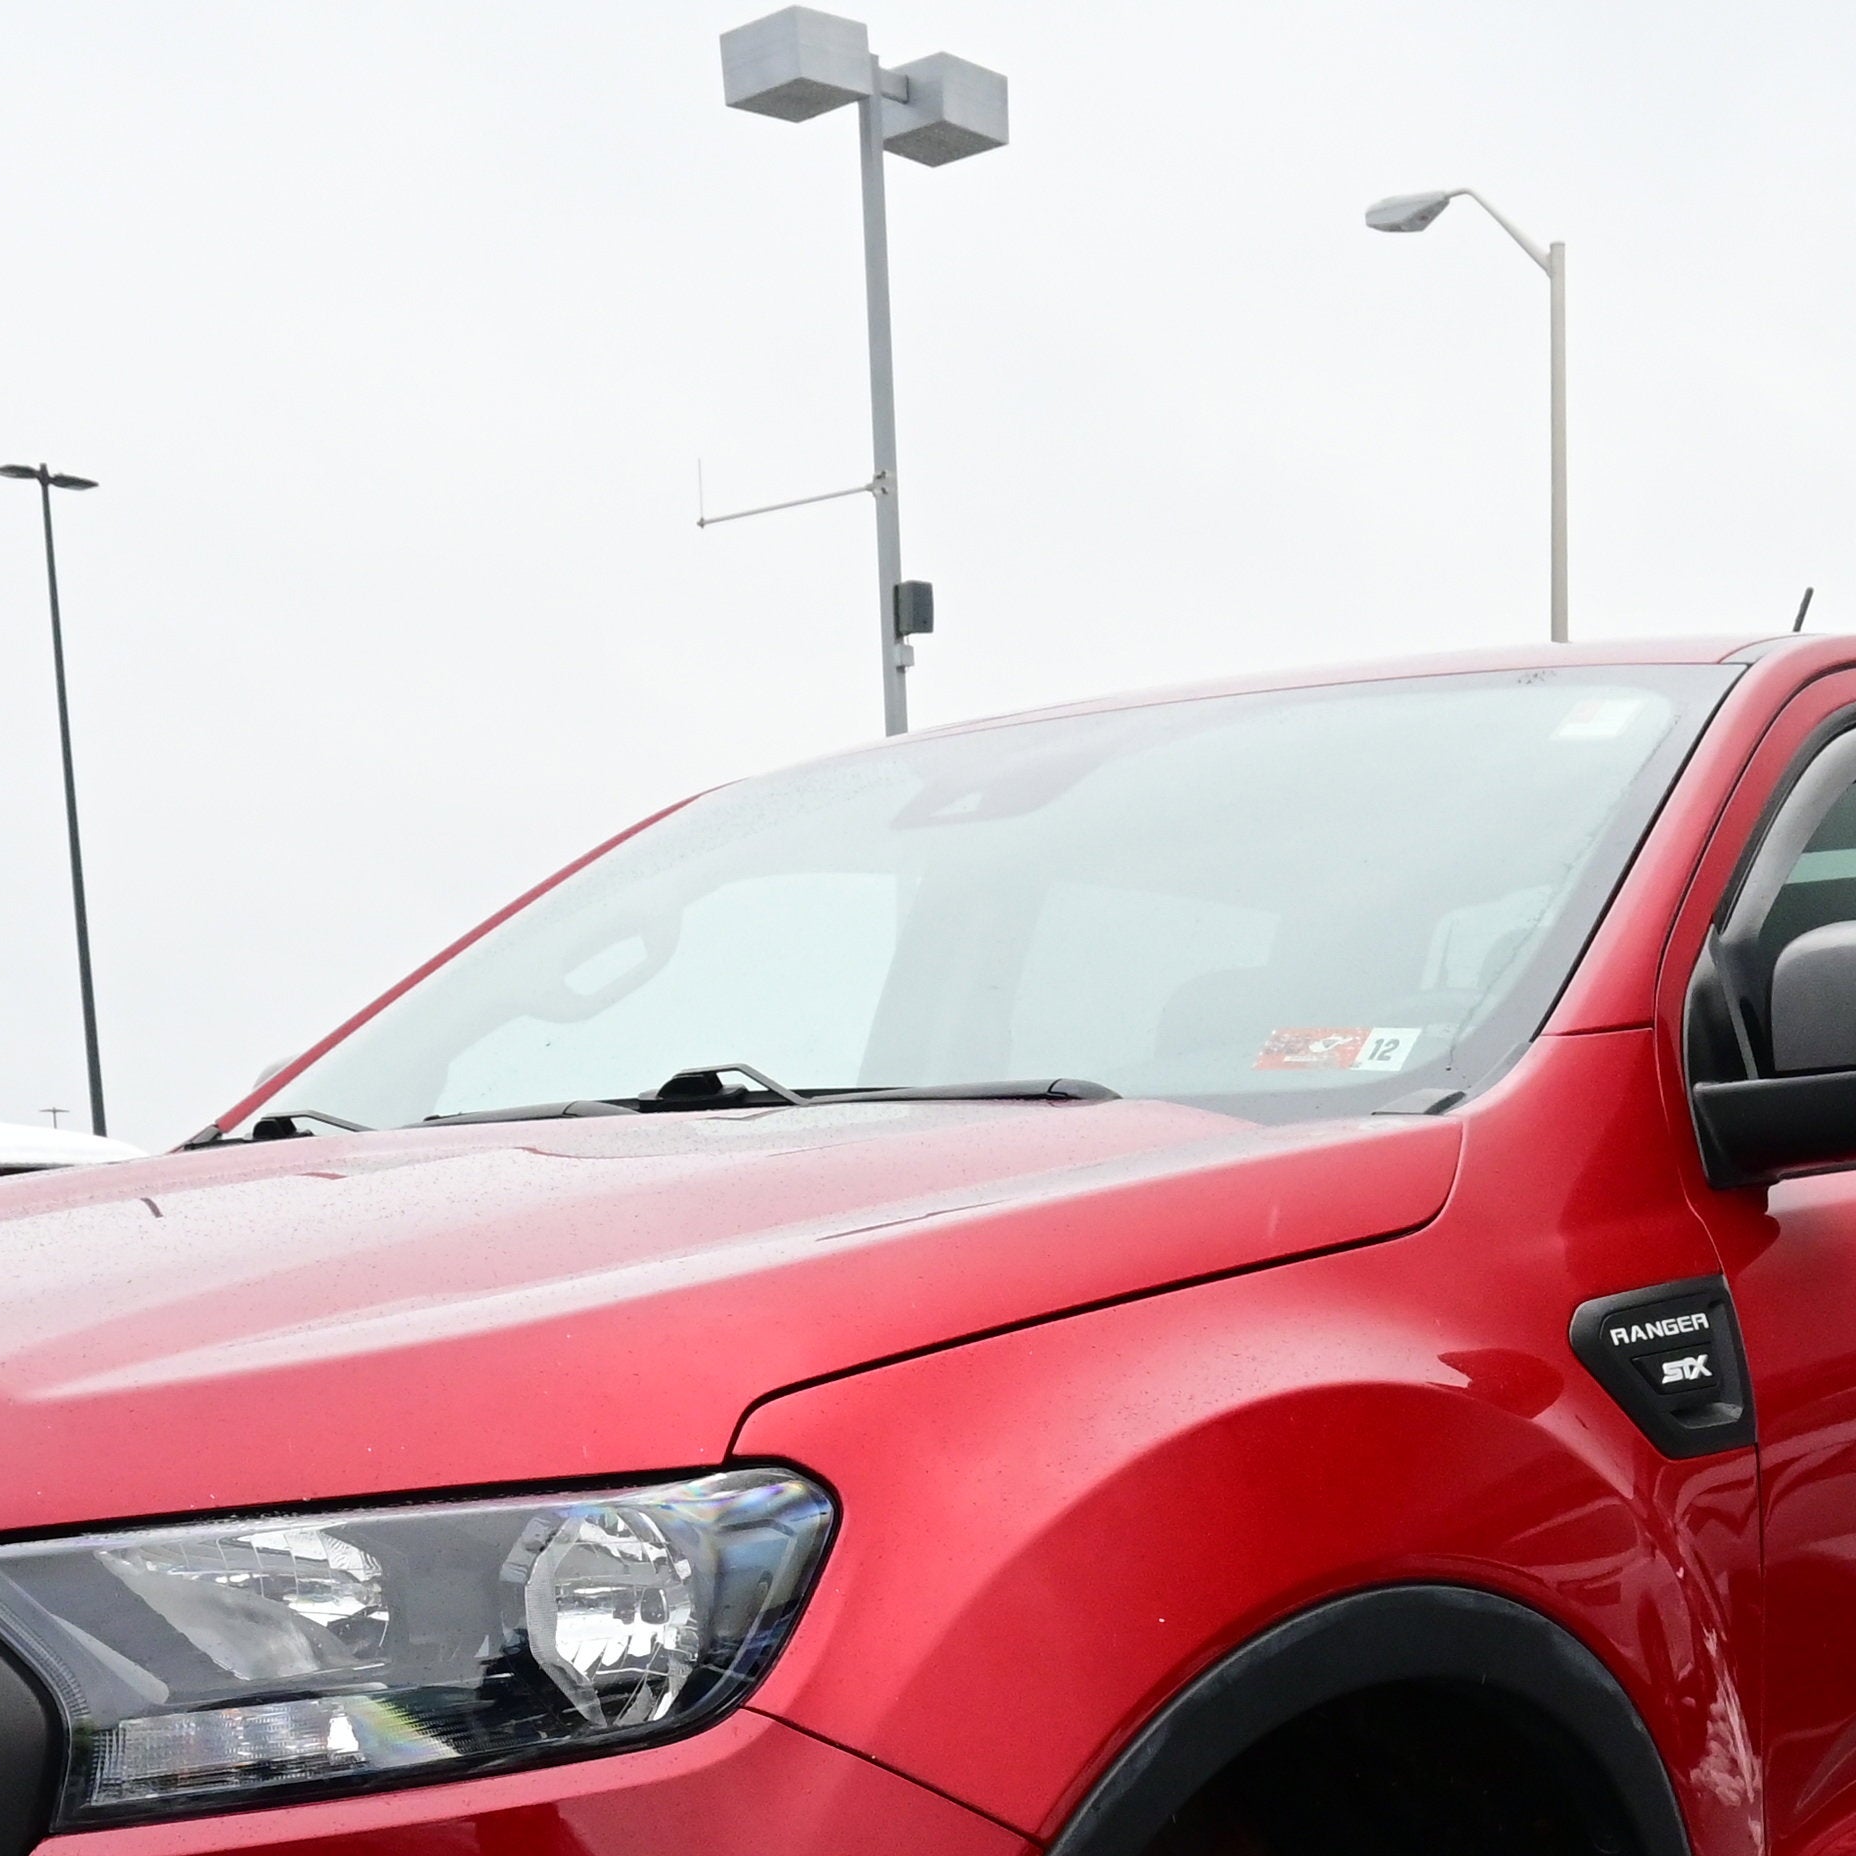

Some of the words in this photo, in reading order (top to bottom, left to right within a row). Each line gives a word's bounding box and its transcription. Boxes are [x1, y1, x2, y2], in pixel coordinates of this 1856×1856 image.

[1368, 1038, 1400, 1062] 12
[1609, 1312, 1710, 1346] RANGER
[1661, 1354, 1713, 1385] STX
